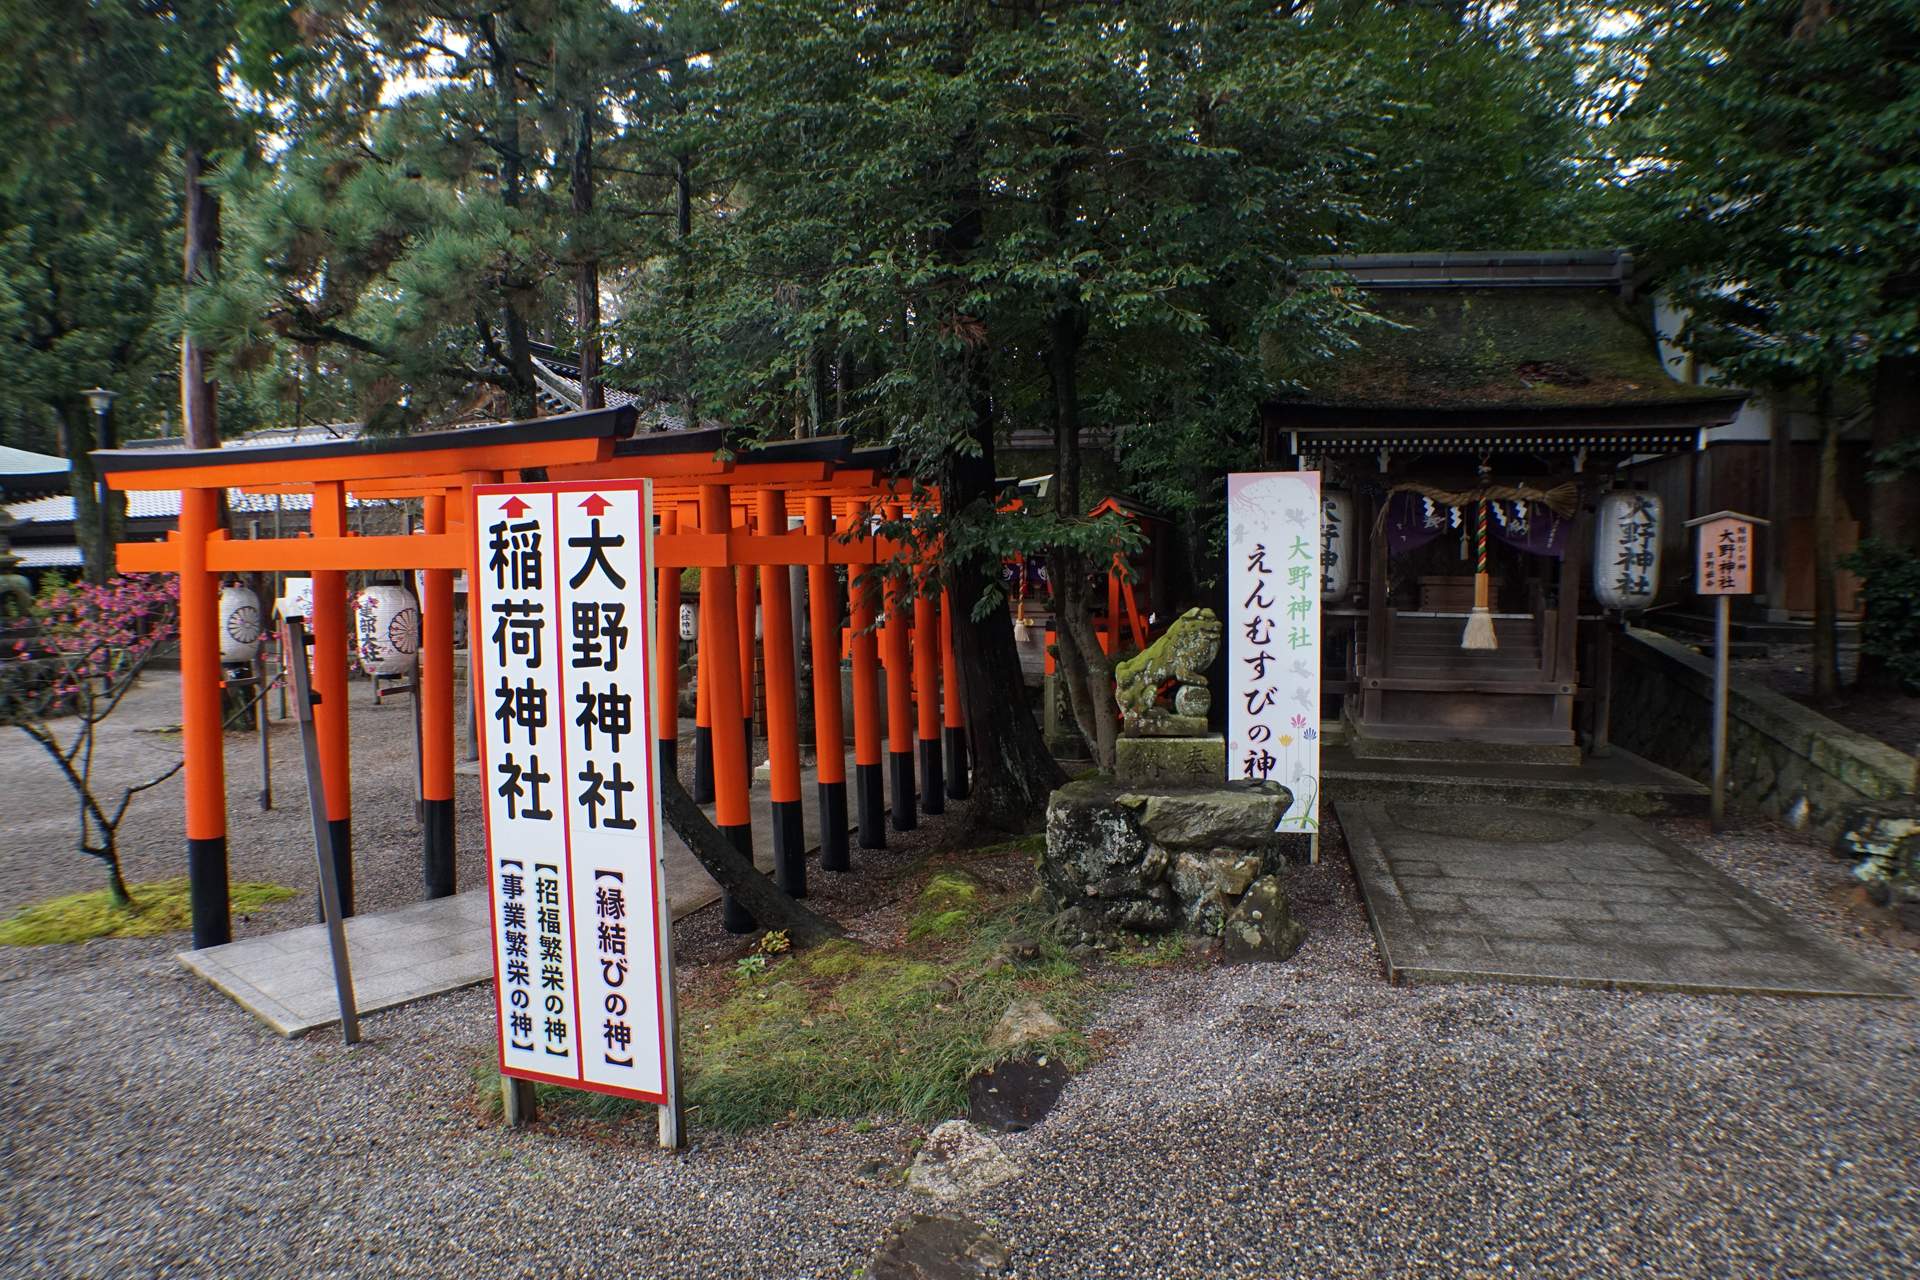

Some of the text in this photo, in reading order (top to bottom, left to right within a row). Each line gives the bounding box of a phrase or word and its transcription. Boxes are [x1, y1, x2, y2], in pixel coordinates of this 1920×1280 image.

[1286, 534, 1314, 651] 大野神社
[1612, 495, 1657, 596] 大野神社
[1717, 528, 1736, 591] 大野神社
[488, 519, 553, 821] 稲荷神社
[568, 518, 637, 831] 大野神社
[1243, 543, 1278, 779] えんむすびの神
[501, 859, 534, 1052] 【事業繁栄の神】
[535, 863, 569, 1058] 【招福繁栄の神】
[595, 869, 633, 1068] 【縁結びの神】
